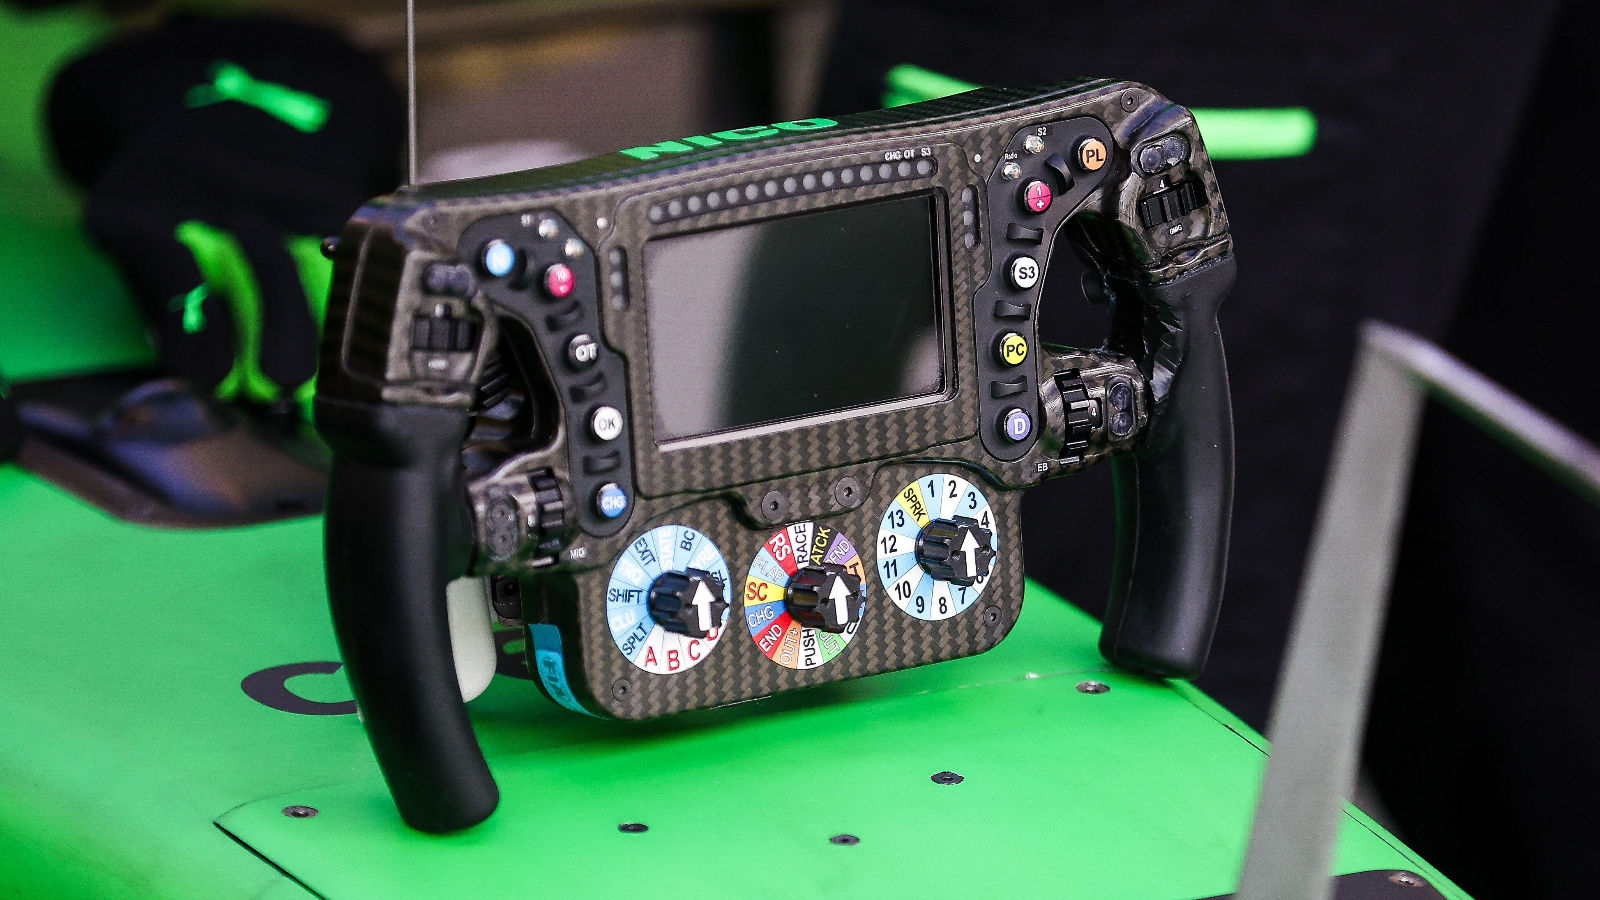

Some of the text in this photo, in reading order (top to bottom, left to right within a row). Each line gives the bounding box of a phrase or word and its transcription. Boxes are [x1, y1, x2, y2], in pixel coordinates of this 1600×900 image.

[619, 117, 838, 161] NICO
[1037, 126, 1047, 136] S2
[921, 147, 931, 157] S3
[1085, 150, 1104, 163] PL
[1018, 266, 1036, 279] S3
[1006, 343, 1025, 357] PC
[598, 417, 616, 431] OK
[1014, 418, 1026, 435] D
[1037, 462, 1048, 472] EB
[928, 480, 935, 498] 1
[948, 480, 957, 498] 2
[903, 487, 927, 522] SPRK
[967, 491, 977, 510] 3
[887, 509, 905, 529] 13
[981, 510, 989, 528] 4
[680, 530, 695, 552] BC
[768, 532, 792, 561] RS
[794, 523, 809, 564] RACE
[810, 526, 831, 565] ATCK
[880, 534, 898, 555] 12
[634, 537, 656, 566] EXIT
[752, 555, 785, 582] F-LAP
[883, 558, 898, 579] 11
[608, 588, 643, 603] SHIFT
[746, 581, 768, 601] SC
[894, 580, 912, 600] 10
[957, 587, 967, 604] 7
[915, 595, 925, 614] 9
[938, 596, 947, 614] 8
[747, 605, 774, 628] CHG
[621, 622, 648, 655] SPLT
[759, 624, 783, 652] END
[780, 627, 798, 665] OUT+
[802, 629, 816, 667] PUSH
[818, 630, 840, 655] OUT
[644, 646, 657, 667] A
[667, 649, 680, 671] B
[688, 640, 700, 660] C
